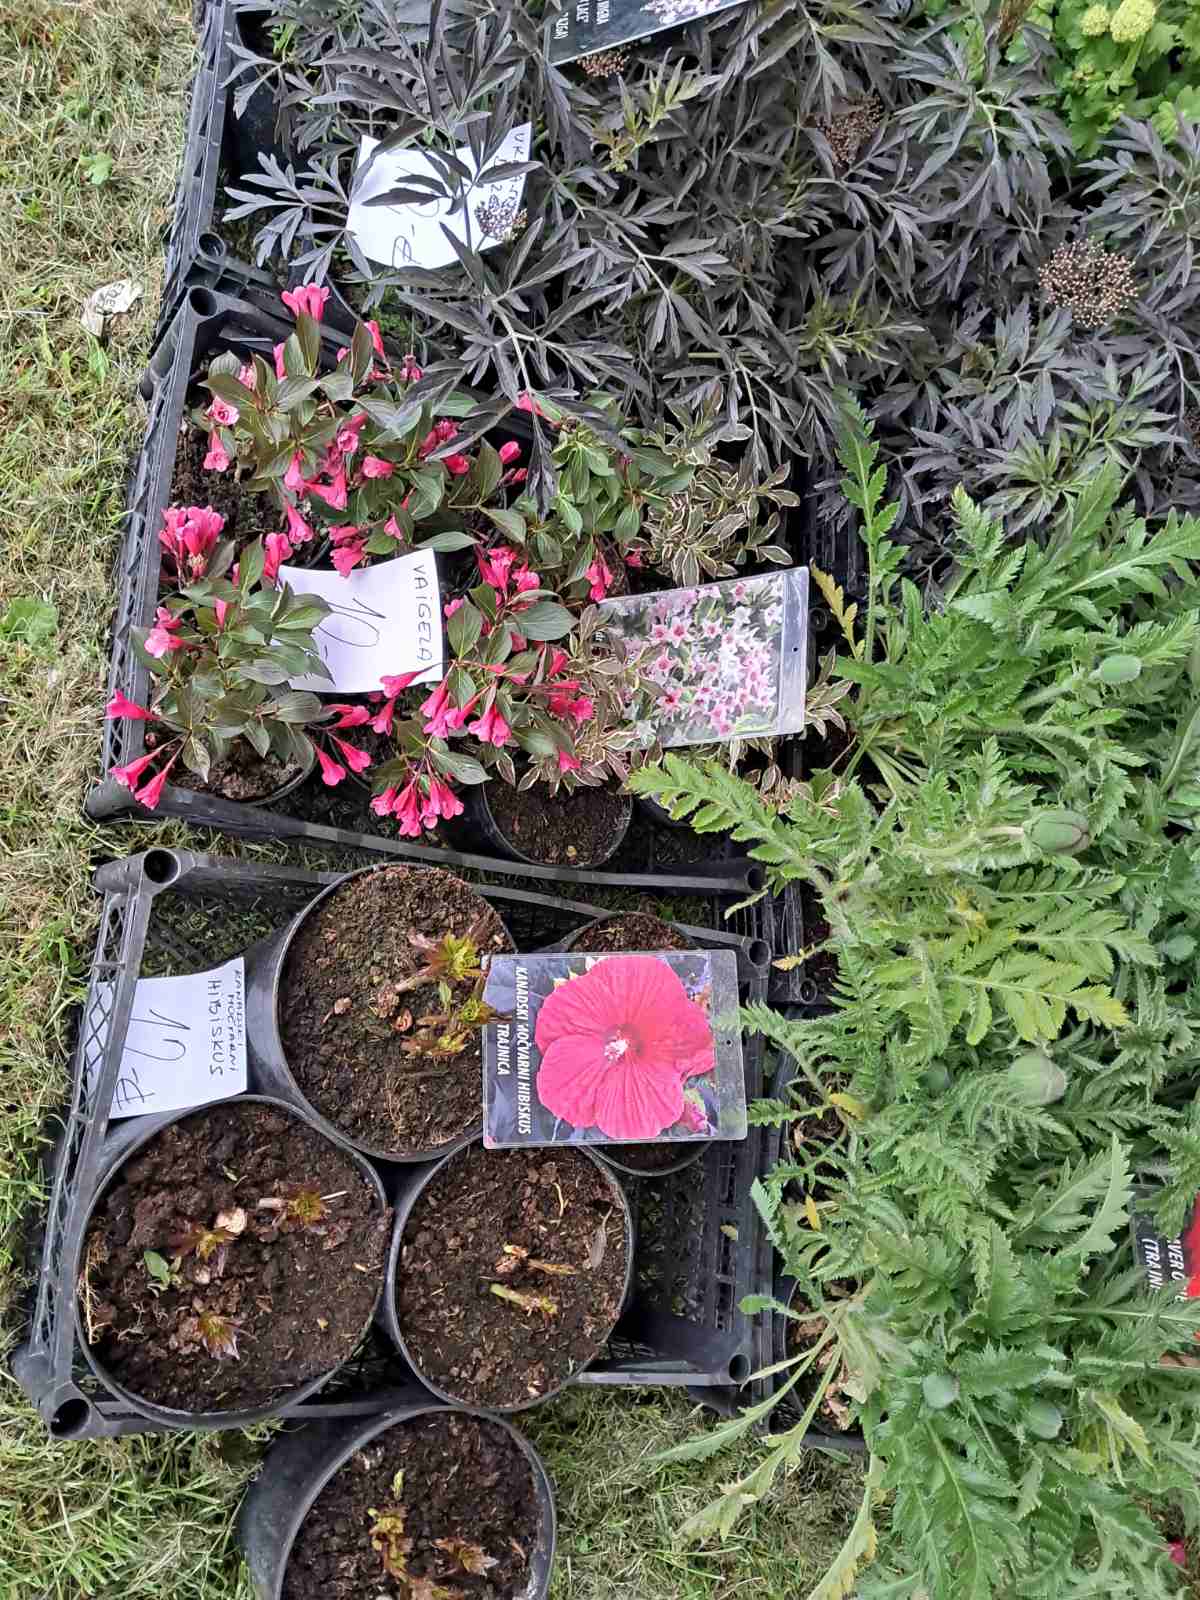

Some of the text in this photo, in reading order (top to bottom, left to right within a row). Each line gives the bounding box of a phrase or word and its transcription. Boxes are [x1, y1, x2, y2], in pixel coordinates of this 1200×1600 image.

[515, 966, 529, 1020] KANADSKI
[497, 1024, 510, 1075] TRAJNICA
[517, 1084, 532, 1135] HIBISKUS
